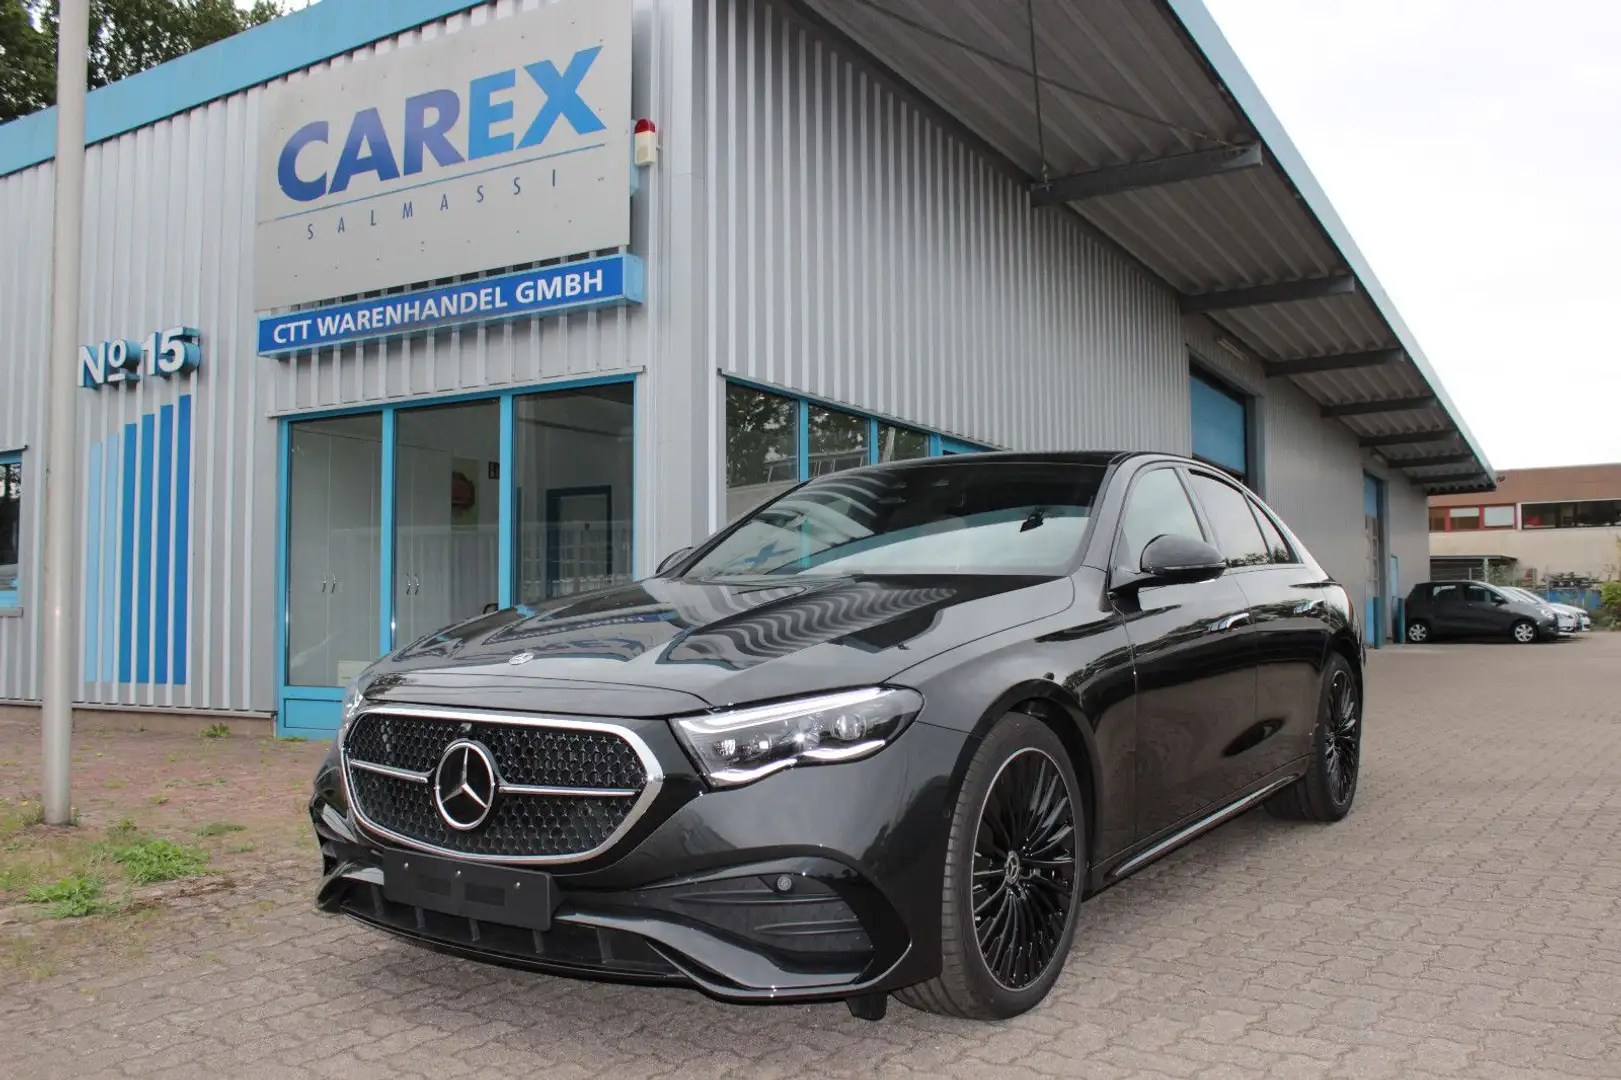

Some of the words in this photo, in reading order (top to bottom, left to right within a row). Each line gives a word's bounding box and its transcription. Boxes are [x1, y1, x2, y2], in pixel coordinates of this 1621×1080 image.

[277, 45, 607, 202] CAREX
[307, 169, 556, 240] SALMASSI
[273, 319, 312, 344] CTT
[317, 287, 508, 337] WARENHANDEL
[515, 269, 604, 304] GMBH
[141, 326, 192, 376] 15
